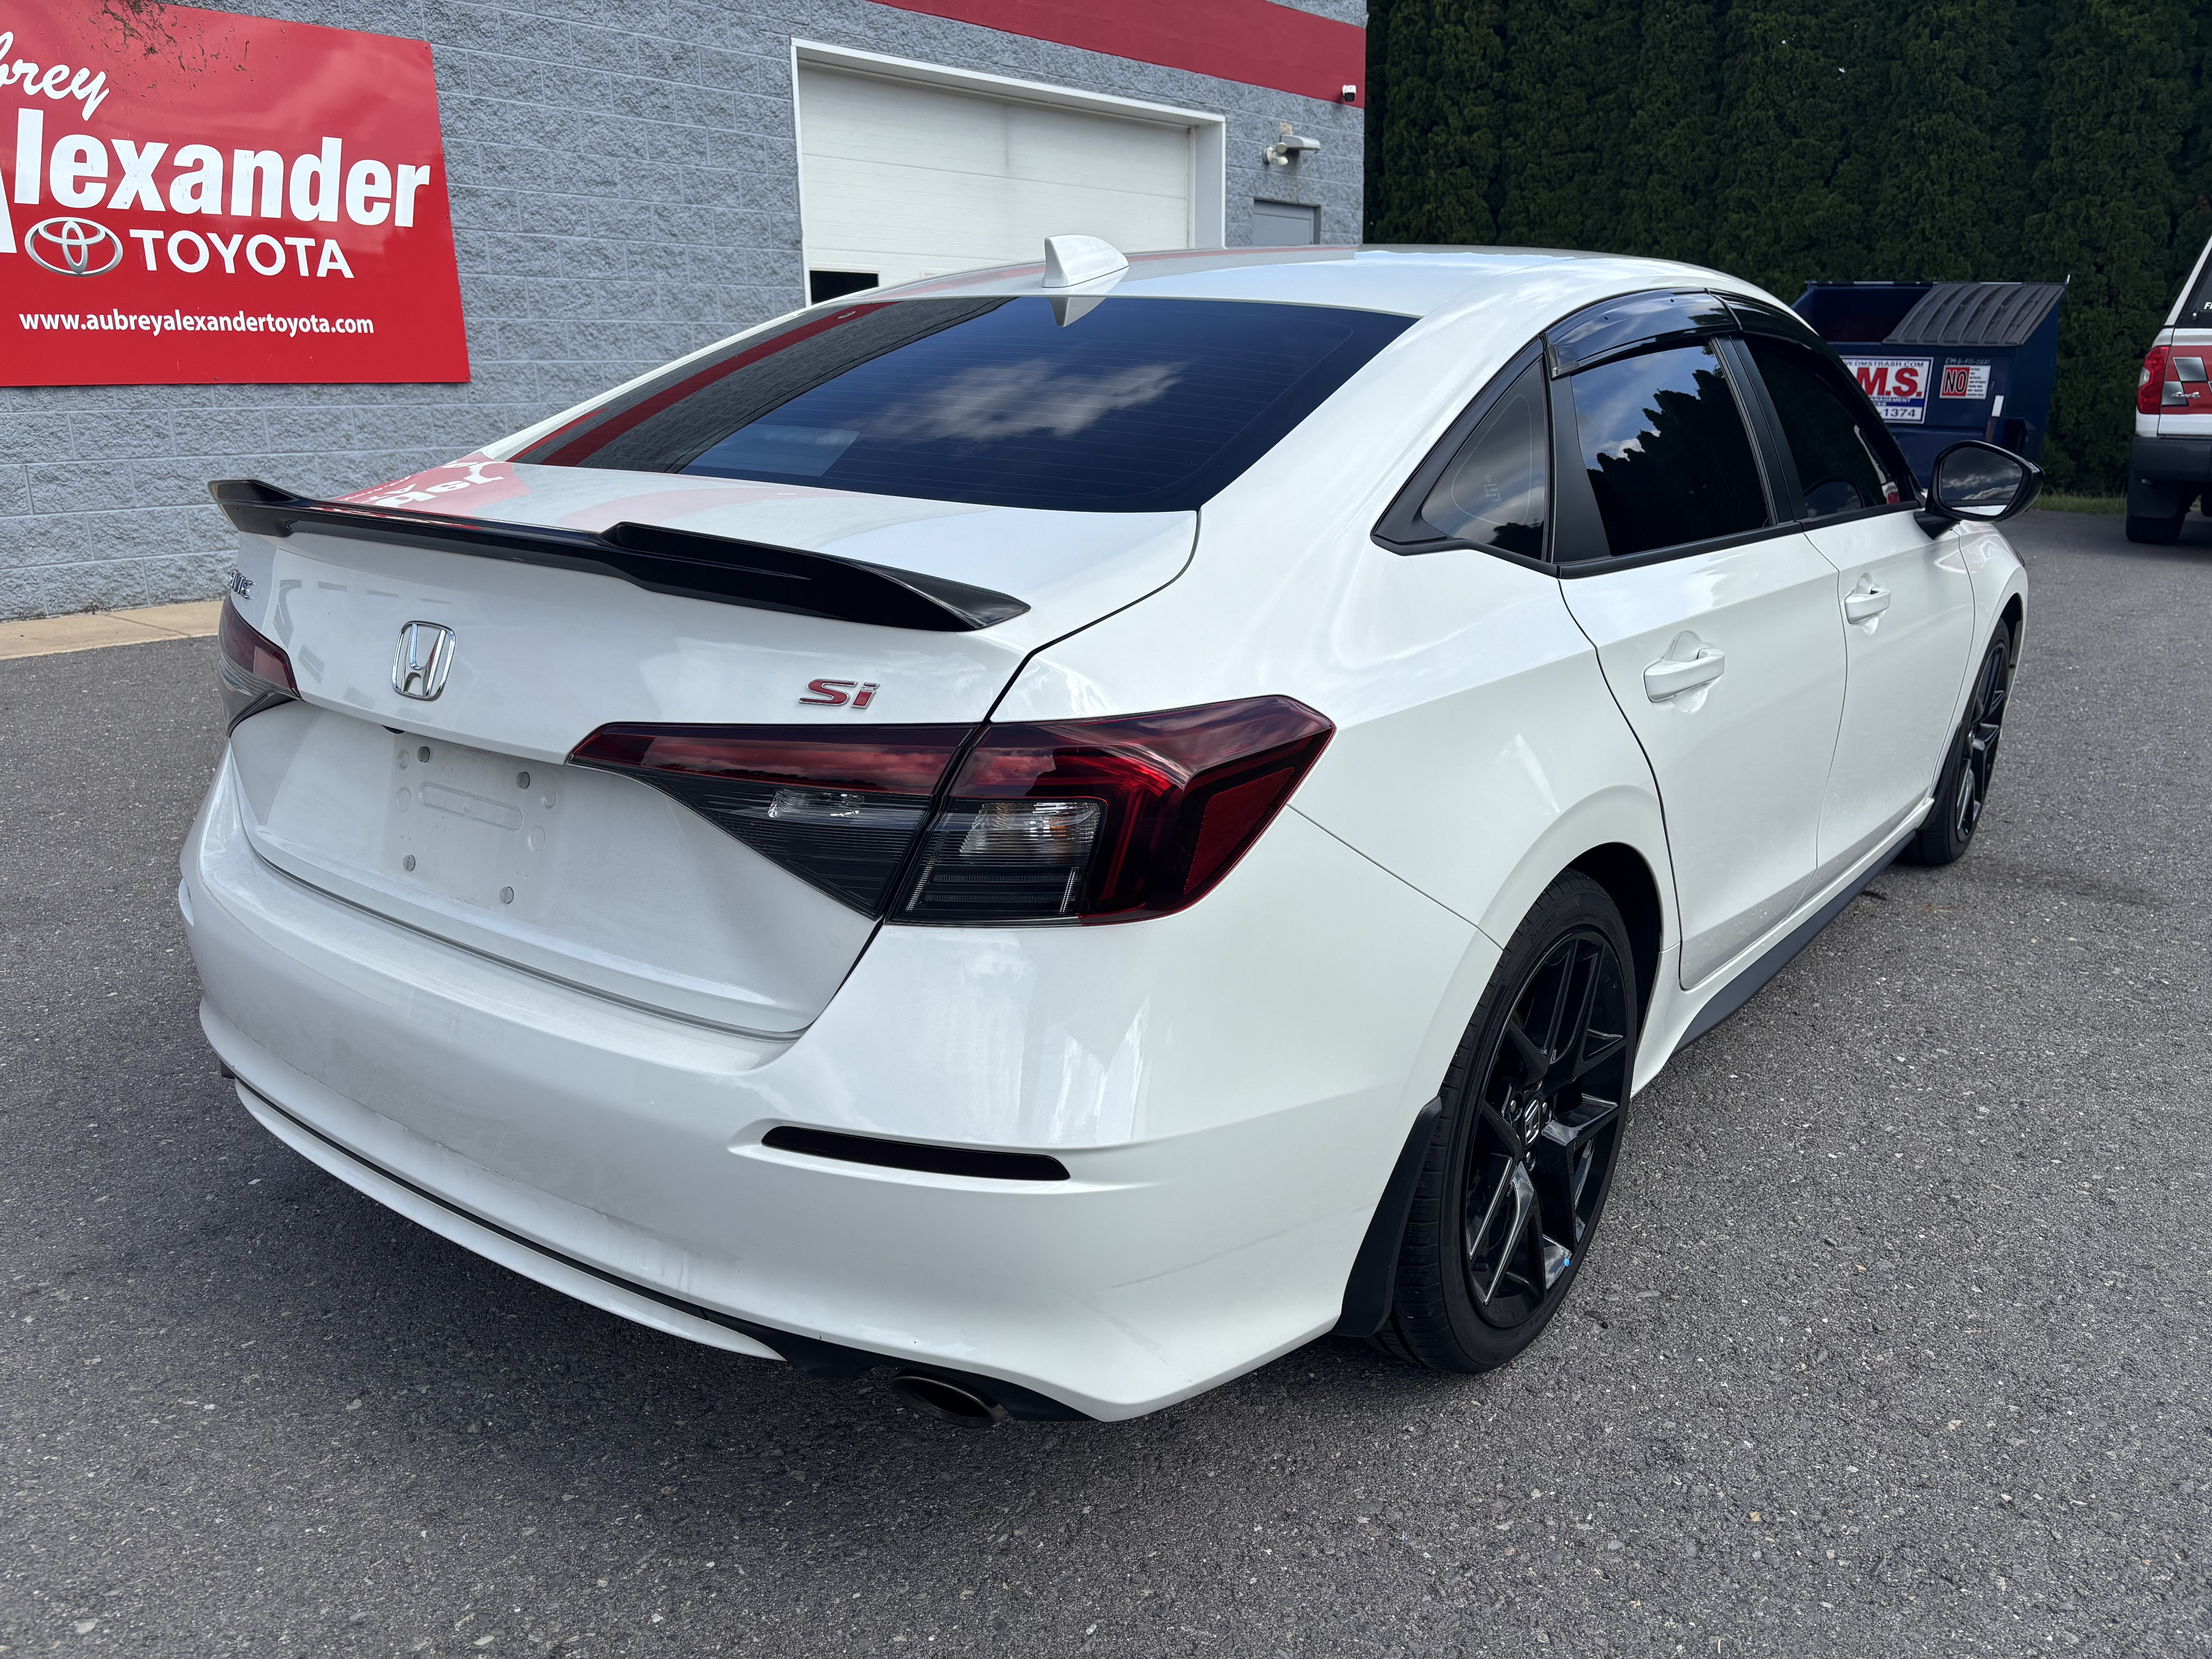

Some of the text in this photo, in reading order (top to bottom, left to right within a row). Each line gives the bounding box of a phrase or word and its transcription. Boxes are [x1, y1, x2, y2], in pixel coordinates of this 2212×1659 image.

[129, 229, 355, 278] TOYOTA
[19, 308, 374, 338] www.aubreyalexandertoyota.com
[1944, 369, 1967, 394] NO
[799, 678, 880, 709] Si
